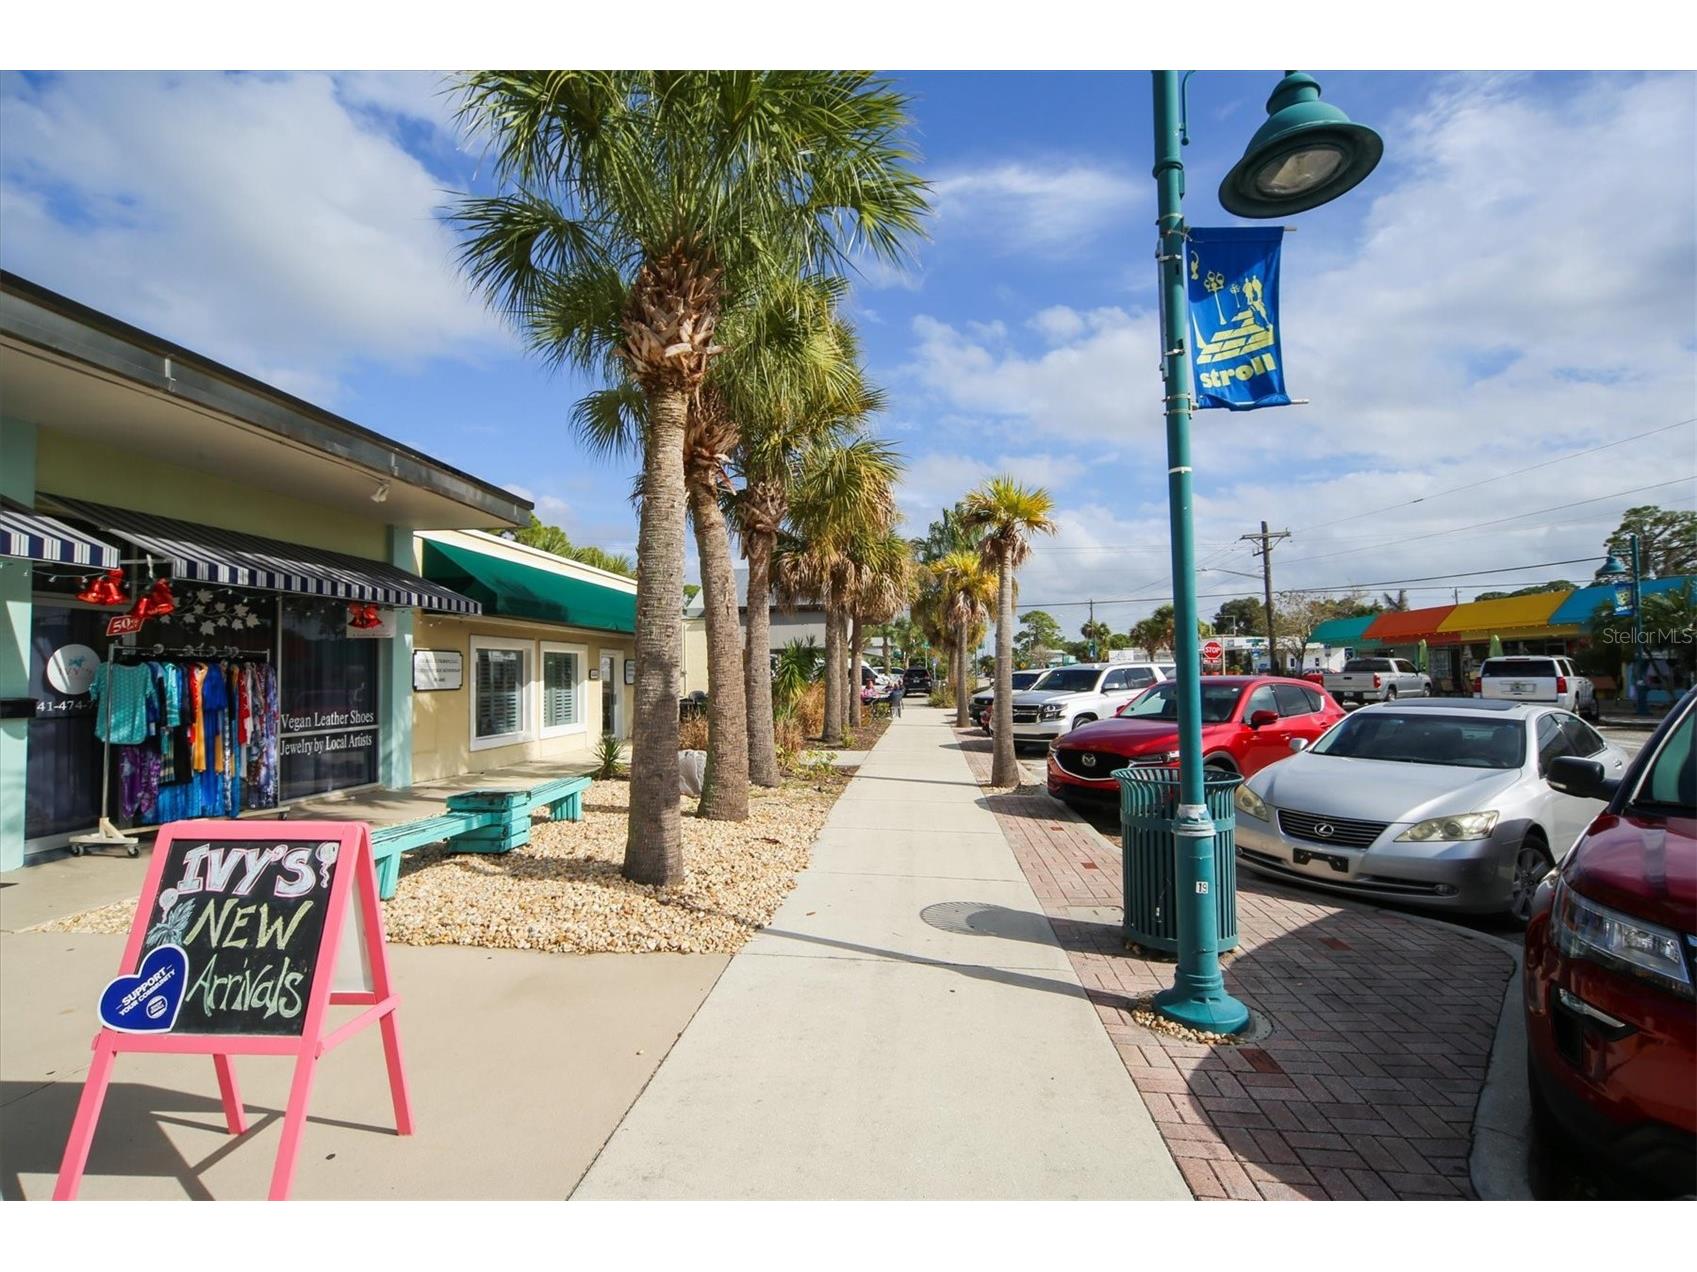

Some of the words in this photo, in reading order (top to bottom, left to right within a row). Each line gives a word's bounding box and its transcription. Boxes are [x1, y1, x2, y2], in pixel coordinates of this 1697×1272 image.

[1200, 353, 1276, 388] stroll
[281, 714, 311, 731] Vegan
[314, 711, 349, 727] Leather
[350, 709, 374, 724] Shoes
[280, 738, 313, 755] Jewelry
[314, 737, 324, 754] by
[325, 734, 347, 750] Local
[348, 732, 372, 748] Artists
[177, 843, 316, 897] IVY'S
[1198, 882, 1207, 892] 19
[184, 898, 313, 950] NEW
[118, 1000, 139, 1016] YOUR
[138, 968, 176, 1002] COMMUNITY
[121, 966, 166, 1006] SUPPORT
[185, 953, 304, 1018] Arrivals
